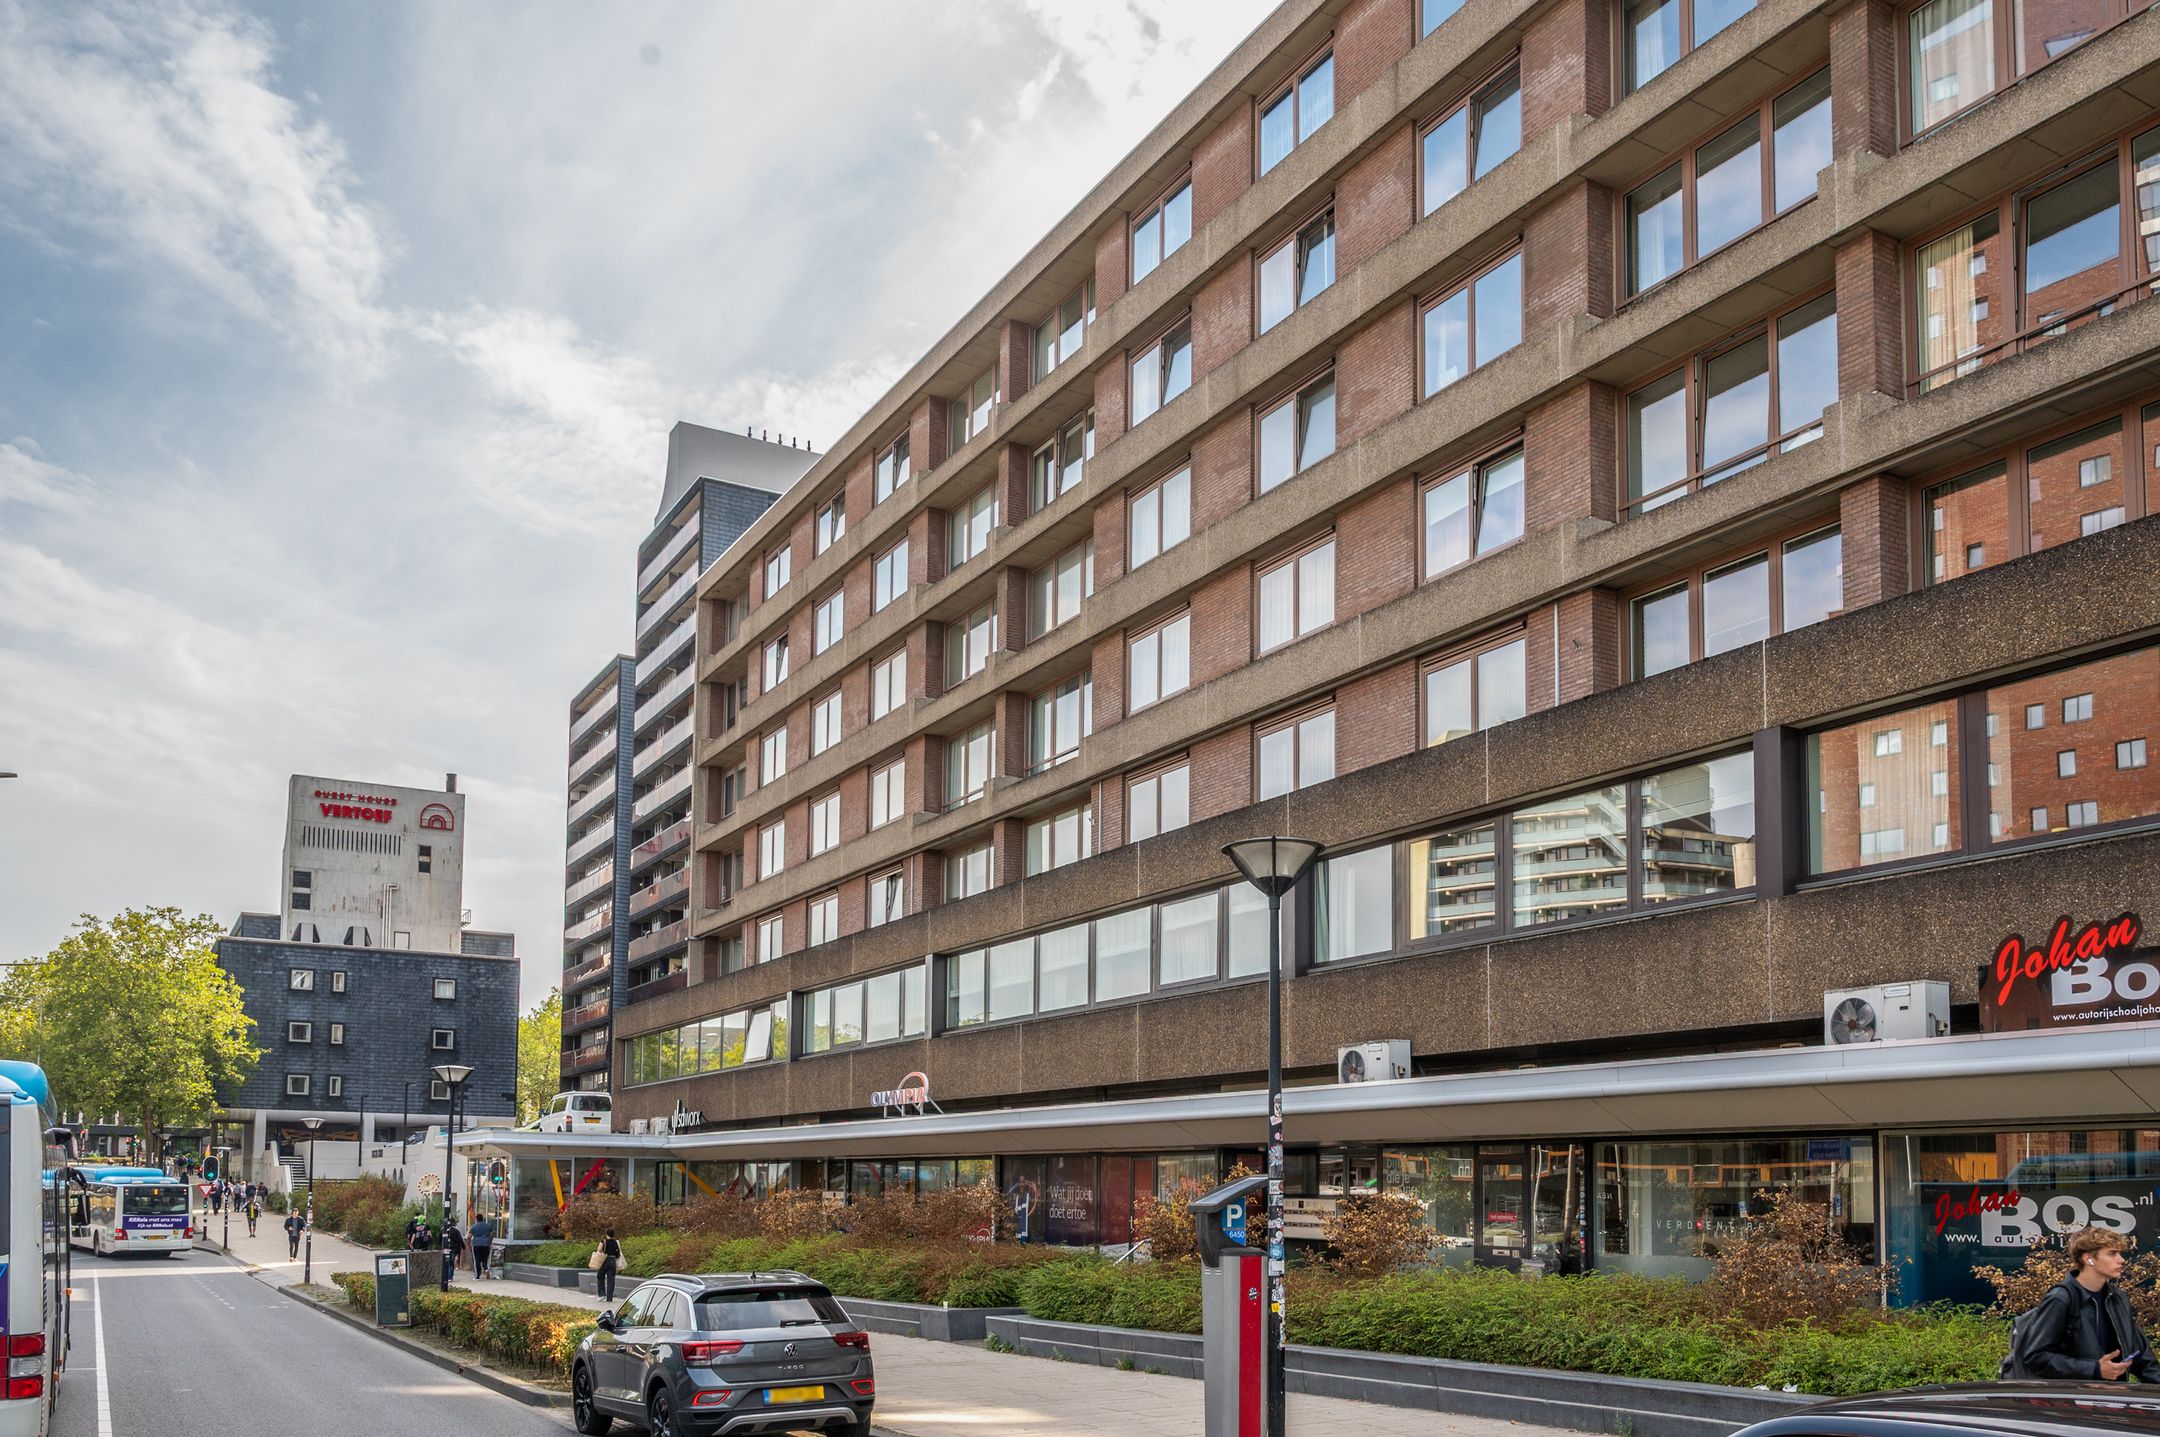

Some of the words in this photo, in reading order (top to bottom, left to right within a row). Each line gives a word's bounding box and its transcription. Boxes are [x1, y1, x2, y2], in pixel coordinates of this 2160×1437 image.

[358, 794, 397, 806] HOUSE
[320, 803, 392, 824] VERTOEF
[1996, 918, 2138, 1007] Johan
[870, 1087, 926, 1107] OLYMPIA
[1049, 1185, 1065, 1200] Wat
[1066, 1185, 1074, 1203] jij
[1049, 1204, 1065, 1219] doet
[1066, 1207, 1087, 1220] ertoe
[1226, 1204, 1243, 1228] P
[1935, 1186, 2021, 1237] Johan
[1981, 1195, 2137, 1247] BOS
[1229, 1230, 1245, 1239] 6450
[1656, 1219, 1734, 1231] VERDENT
[1945, 1233, 1980, 1243] www.
